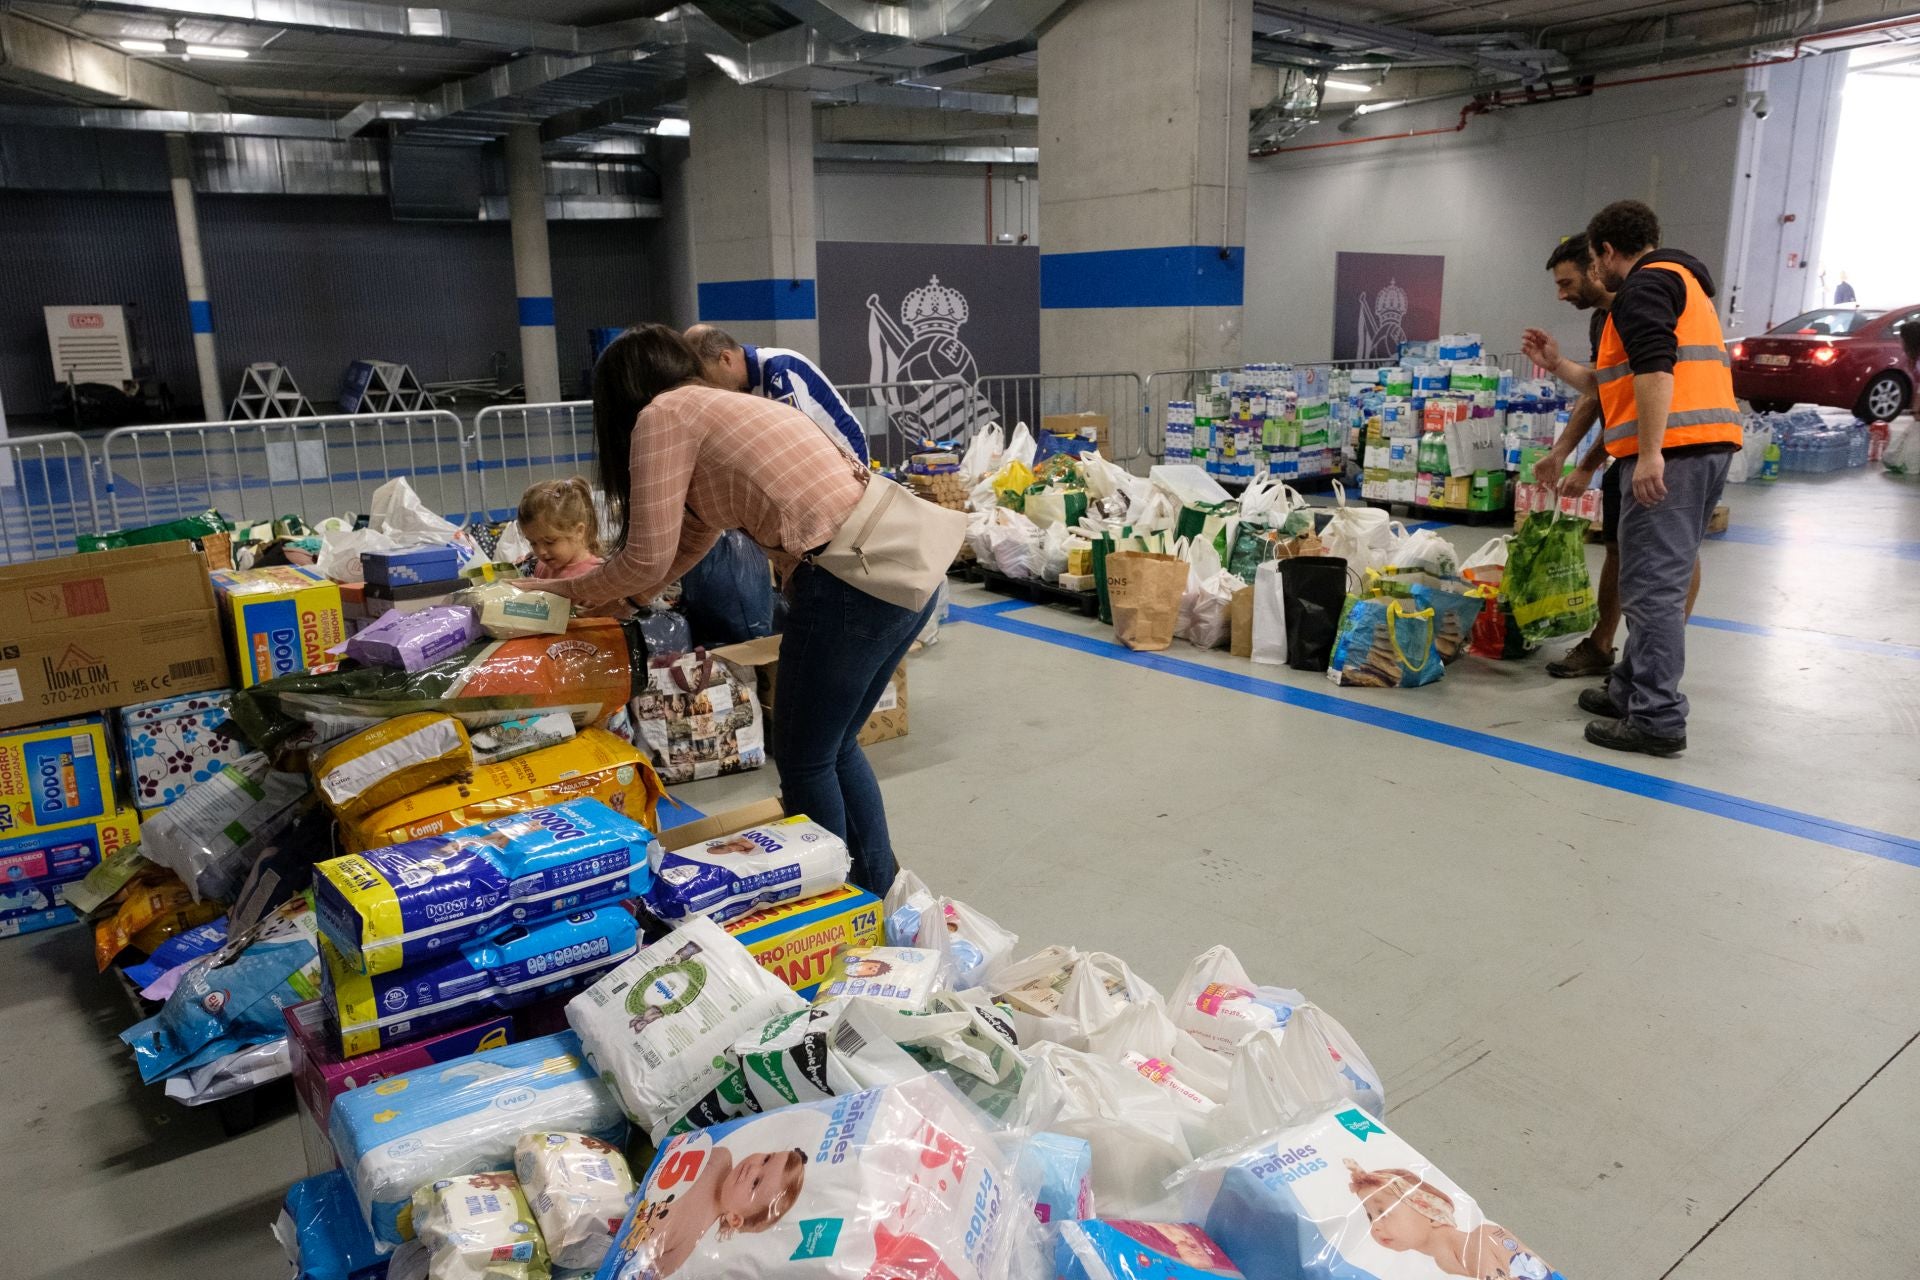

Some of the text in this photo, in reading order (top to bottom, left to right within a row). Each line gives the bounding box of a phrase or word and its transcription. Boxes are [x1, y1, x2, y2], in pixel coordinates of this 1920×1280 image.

[330, 608, 340, 643] AHORRO
[272, 628, 297, 676] DOD
[42, 656, 110, 691] HOMCOM
[151, 674, 171, 689] CE
[41, 681, 119, 705] 370-201WT
[0, 746, 15, 796] AHORRO
[10, 745, 24, 795] POUPANÇA
[38, 755, 63, 813] DODOT
[410, 819, 444, 838] Compy
[742, 830, 783, 853] DODOT
[425, 897, 468, 918] DODOT
[475, 896, 483, 907] 5
[851, 911, 876, 931] 174
[786, 925, 845, 957] POUPANÇA
[772, 942, 847, 987] ANT
[658, 1150, 705, 1190] 5
[1251, 1145, 1317, 1179] Pañales
[1264, 1157, 1329, 1191] Fraldas
